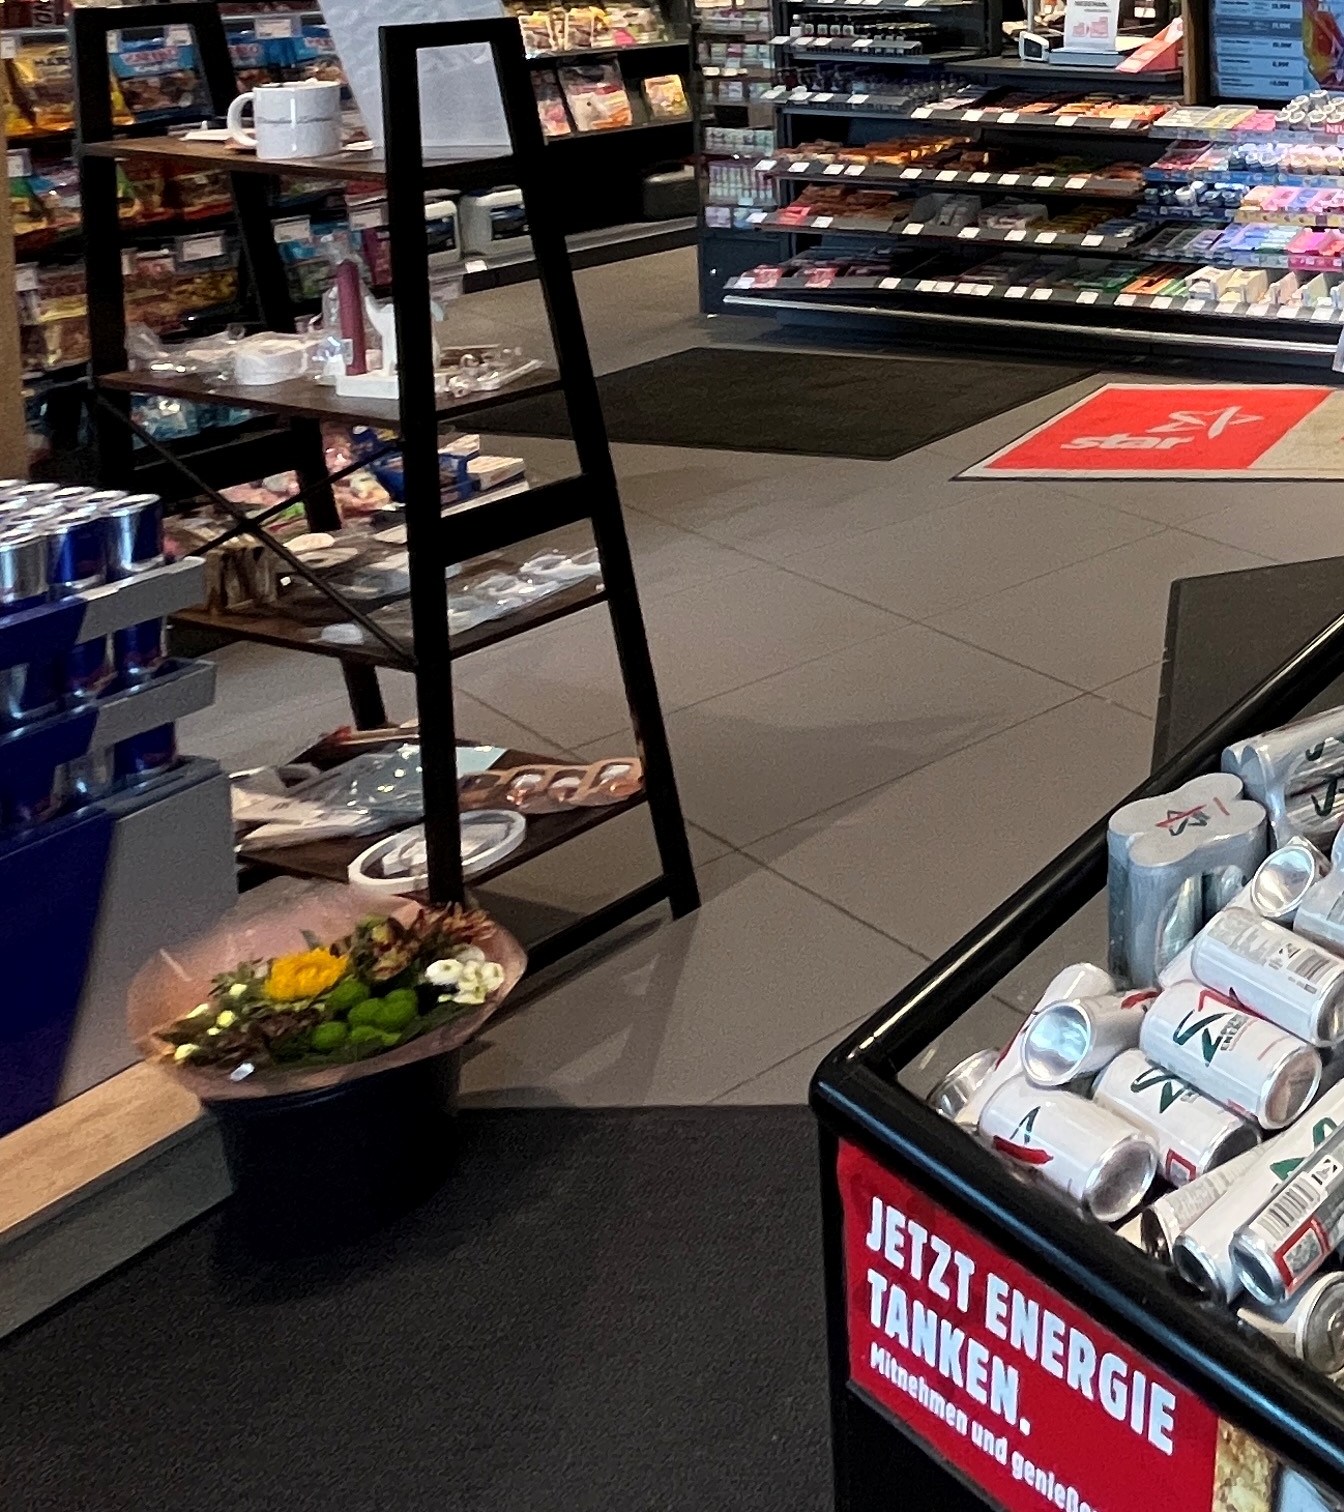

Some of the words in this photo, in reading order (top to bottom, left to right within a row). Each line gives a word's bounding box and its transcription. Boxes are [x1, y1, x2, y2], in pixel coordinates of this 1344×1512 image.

[866, 1196, 976, 1313] JETZT
[984, 1271, 1177, 1456] ENERGIE
[866, 1269, 1031, 1436] TANKEN.
[869, 1341, 969, 1436] Mitnehmen
[971, 1419, 1010, 1466] und
[1012, 1451, 1097, 1512] genieß
